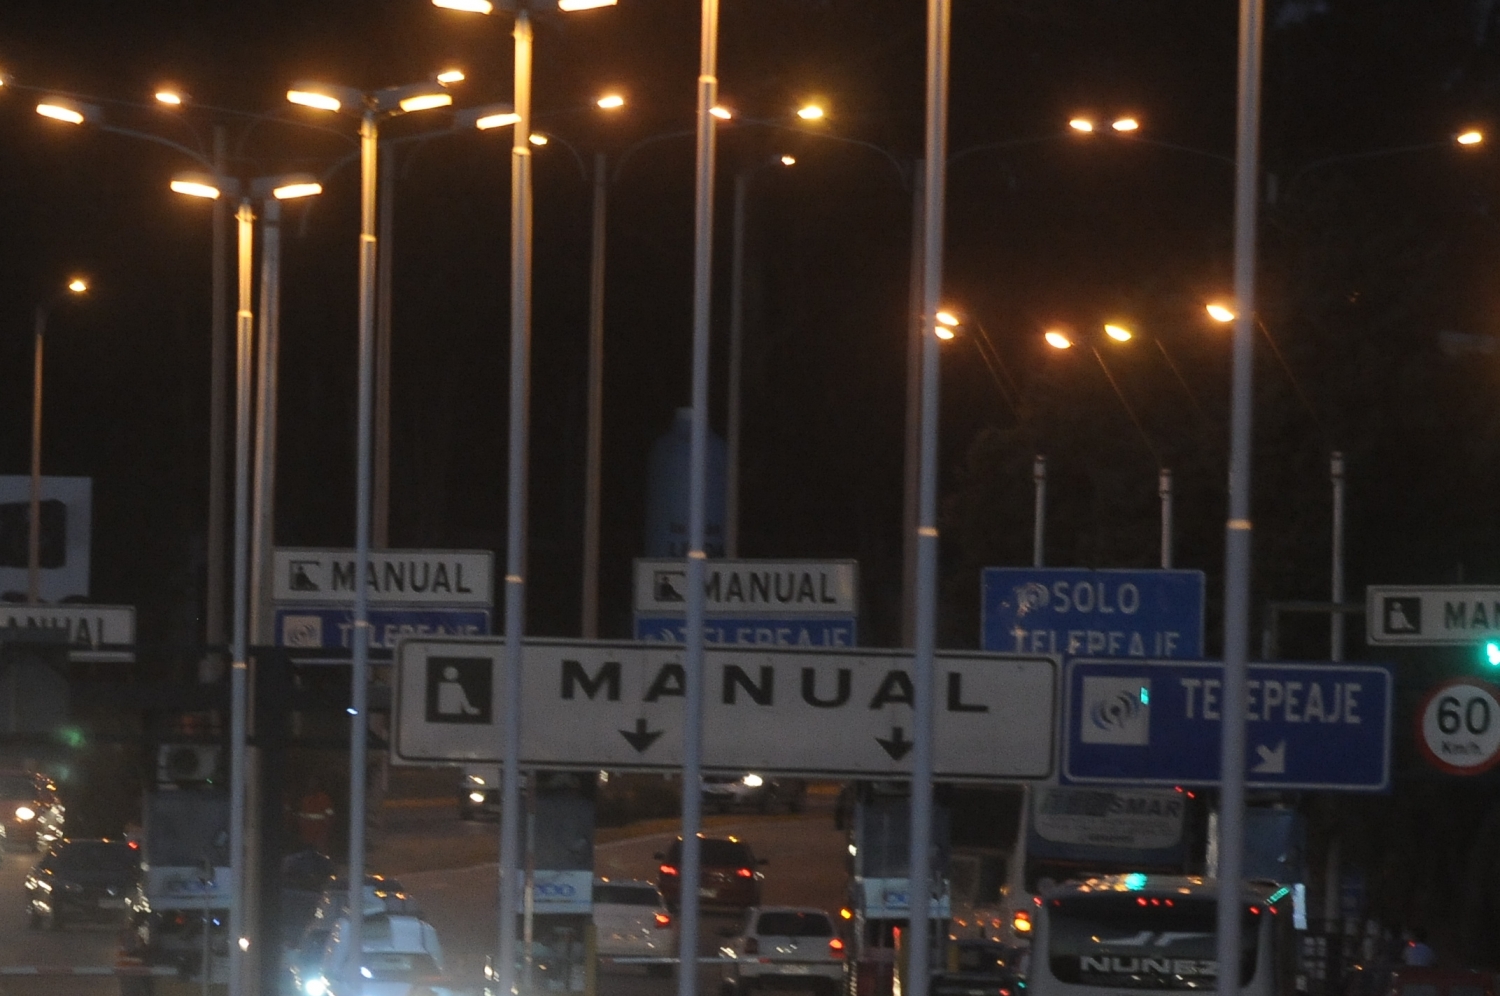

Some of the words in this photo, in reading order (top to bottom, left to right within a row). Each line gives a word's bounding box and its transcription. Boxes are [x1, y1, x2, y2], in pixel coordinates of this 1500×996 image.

[332, 561, 472, 593] MANUAL
[703, 571, 836, 603] MANUAL
[1052, 580, 1140, 614] SOLO
[560, 659, 990, 712] MANUAL
[1180, 677, 1362, 724] TEEPEAJE
[1437, 696, 1490, 735] 60
